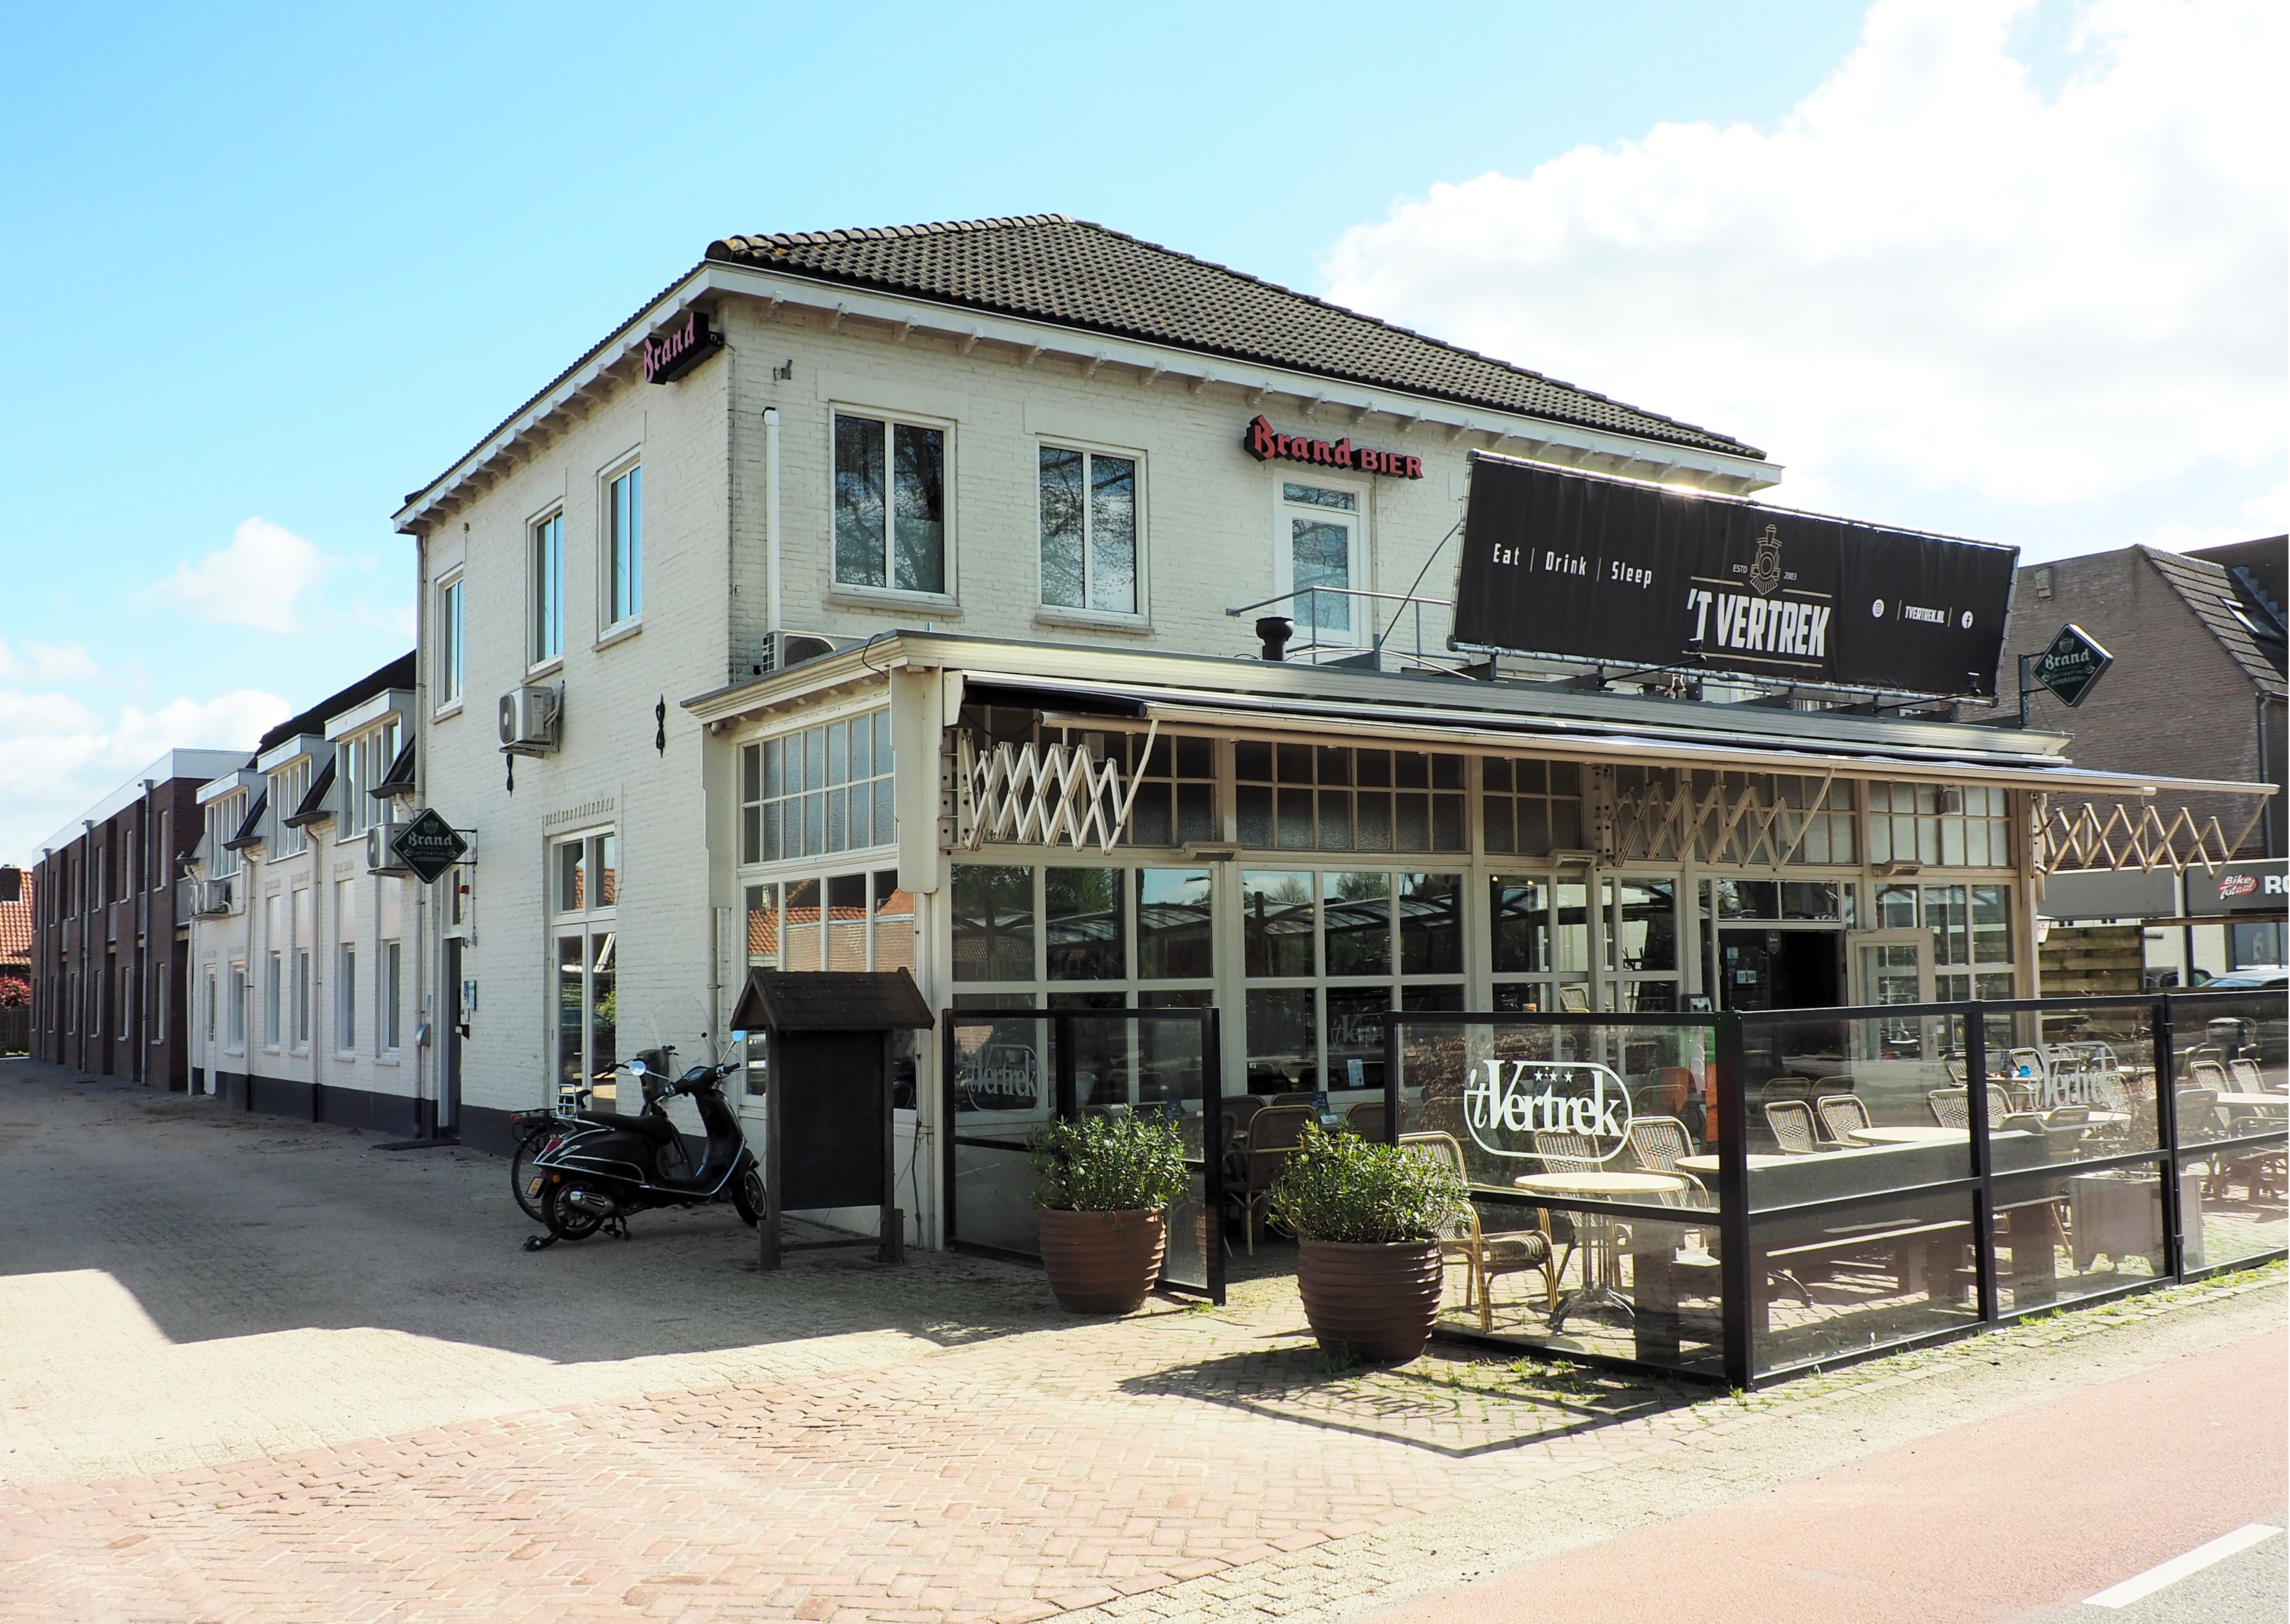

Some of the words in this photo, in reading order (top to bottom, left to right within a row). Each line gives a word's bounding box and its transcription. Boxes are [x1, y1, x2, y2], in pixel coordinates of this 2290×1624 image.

[644, 311, 695, 383] Brand
[1254, 414, 1352, 467] Brand
[1361, 448, 1423, 478] BIER
[1493, 543, 1520, 566] Eat
[1545, 551, 1587, 576] Drink
[1611, 561, 1652, 589] Sleep
[1732, 564, 1748, 574] ESTD
[1784, 571, 1797, 580] 2003
[1717, 593, 1831, 657] VERTREK
[2045, 648, 2090, 670] Brand
[408, 831, 453, 847] Brand
[2220, 880, 2255, 900] Totaal
[2224, 875, 2252, 885] Bike
[2264, 875, 2289, 894] R
